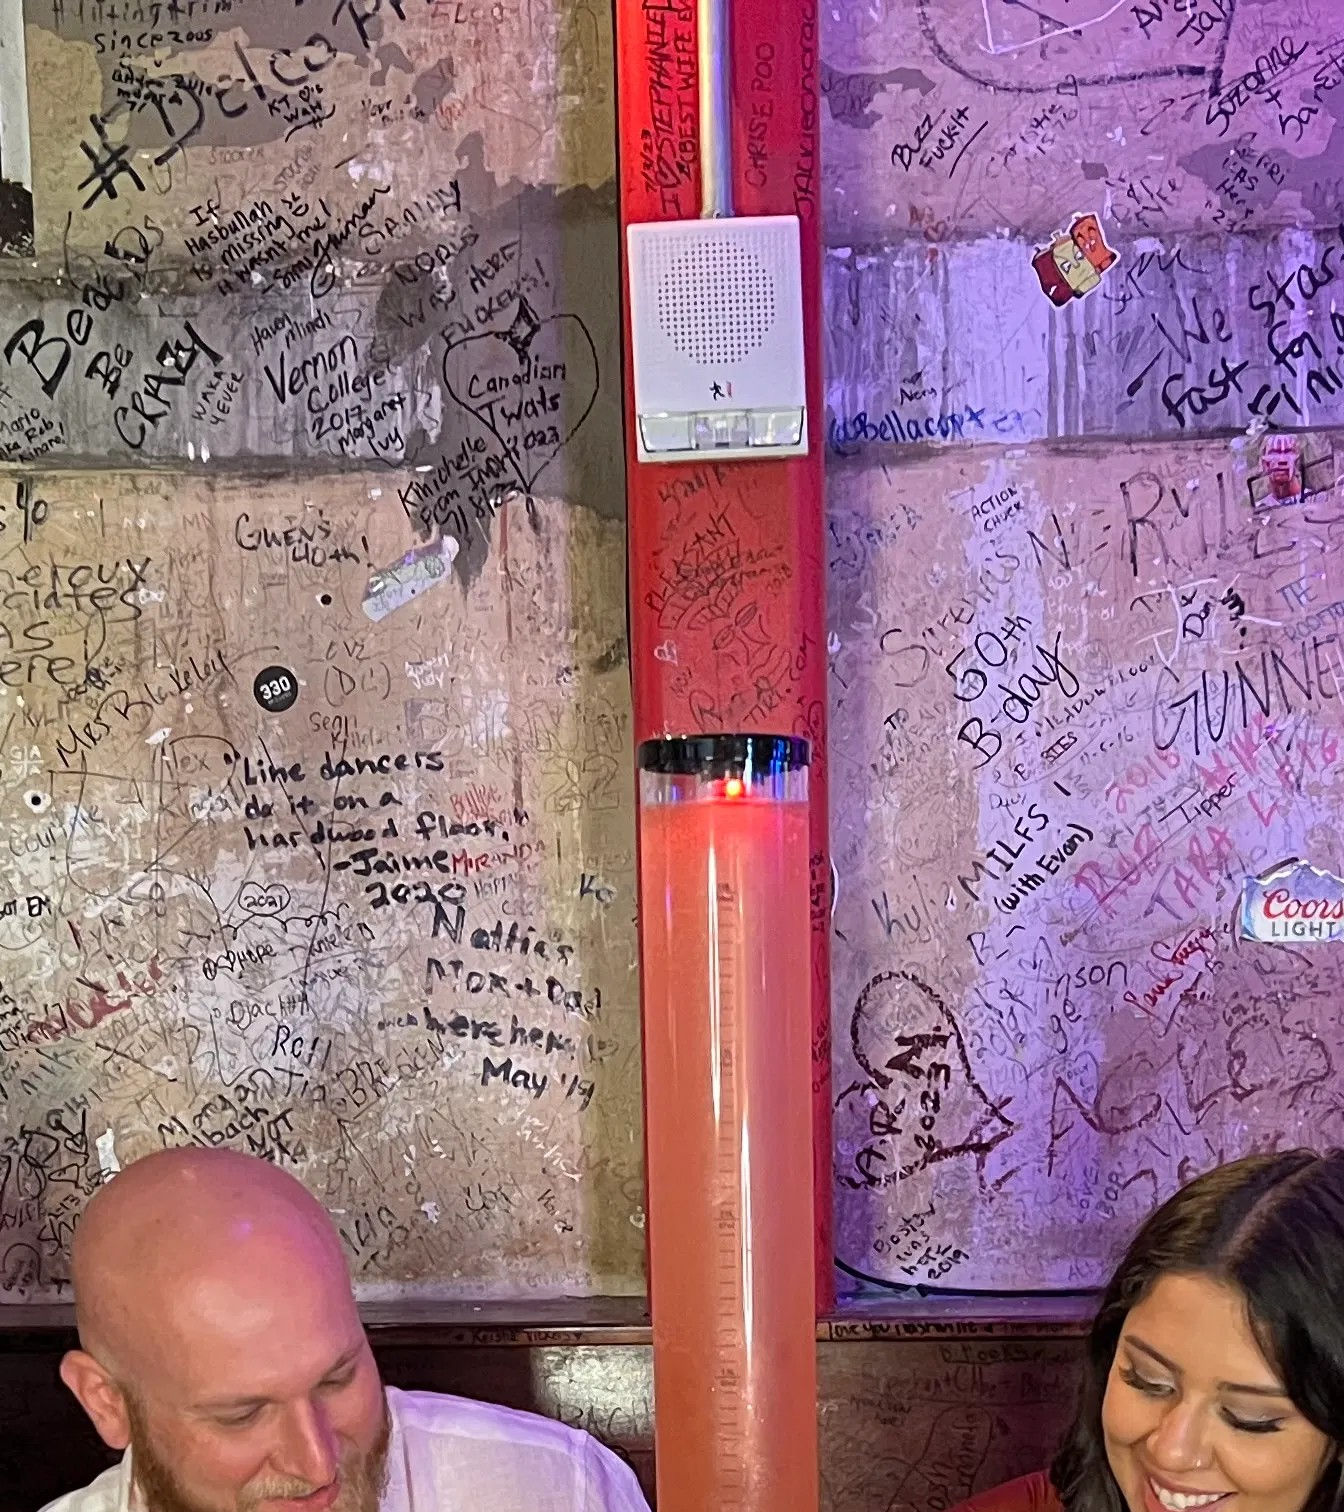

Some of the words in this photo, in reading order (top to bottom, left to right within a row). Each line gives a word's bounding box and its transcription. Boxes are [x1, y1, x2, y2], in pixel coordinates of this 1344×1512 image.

[189, 199, 221, 228] If
[264, 335, 361, 405] Vernon
[259, 675, 292, 700] 330
[379, 790, 402, 812] a
[1270, 920, 1338, 940] LIGHT
